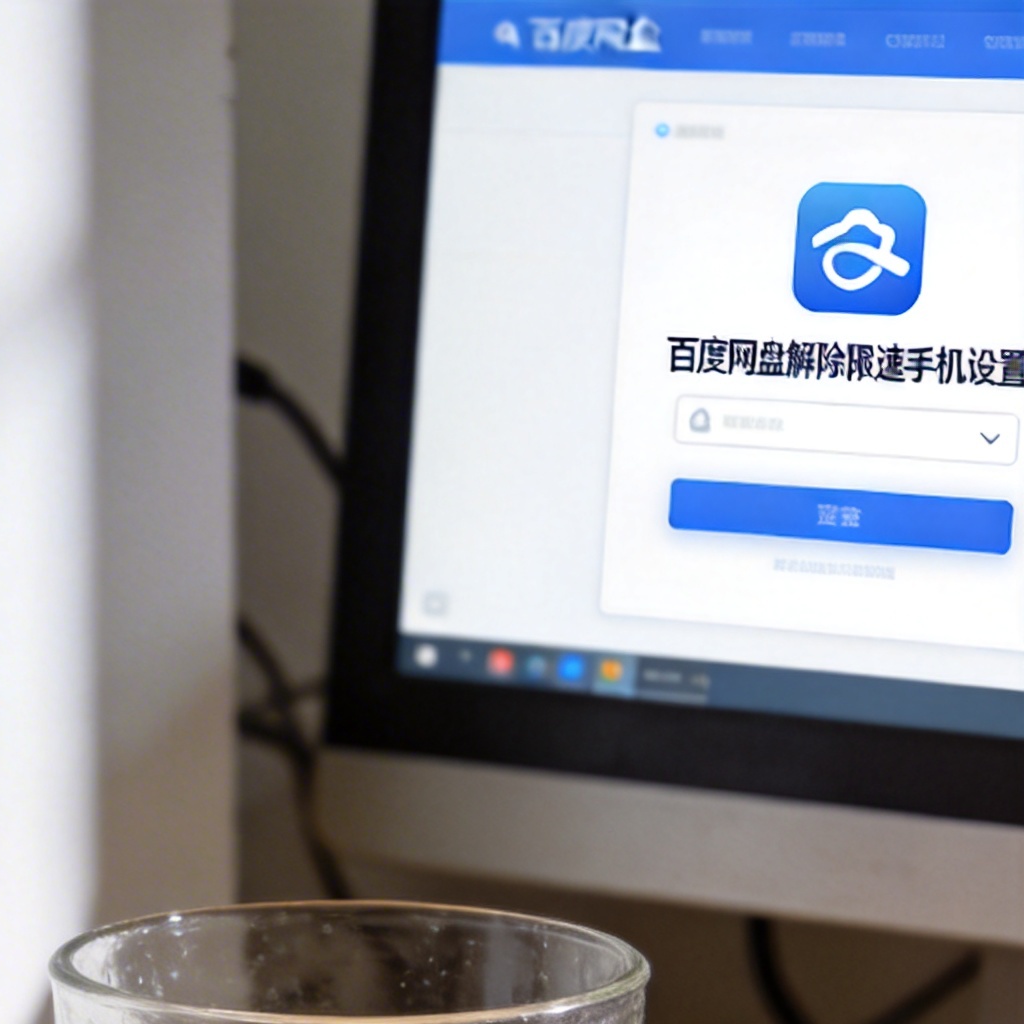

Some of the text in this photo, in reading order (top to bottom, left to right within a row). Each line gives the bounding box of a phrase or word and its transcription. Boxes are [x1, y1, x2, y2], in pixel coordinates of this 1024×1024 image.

[667, 335, 1024, 388] 百度网盘解除限速手机设置
